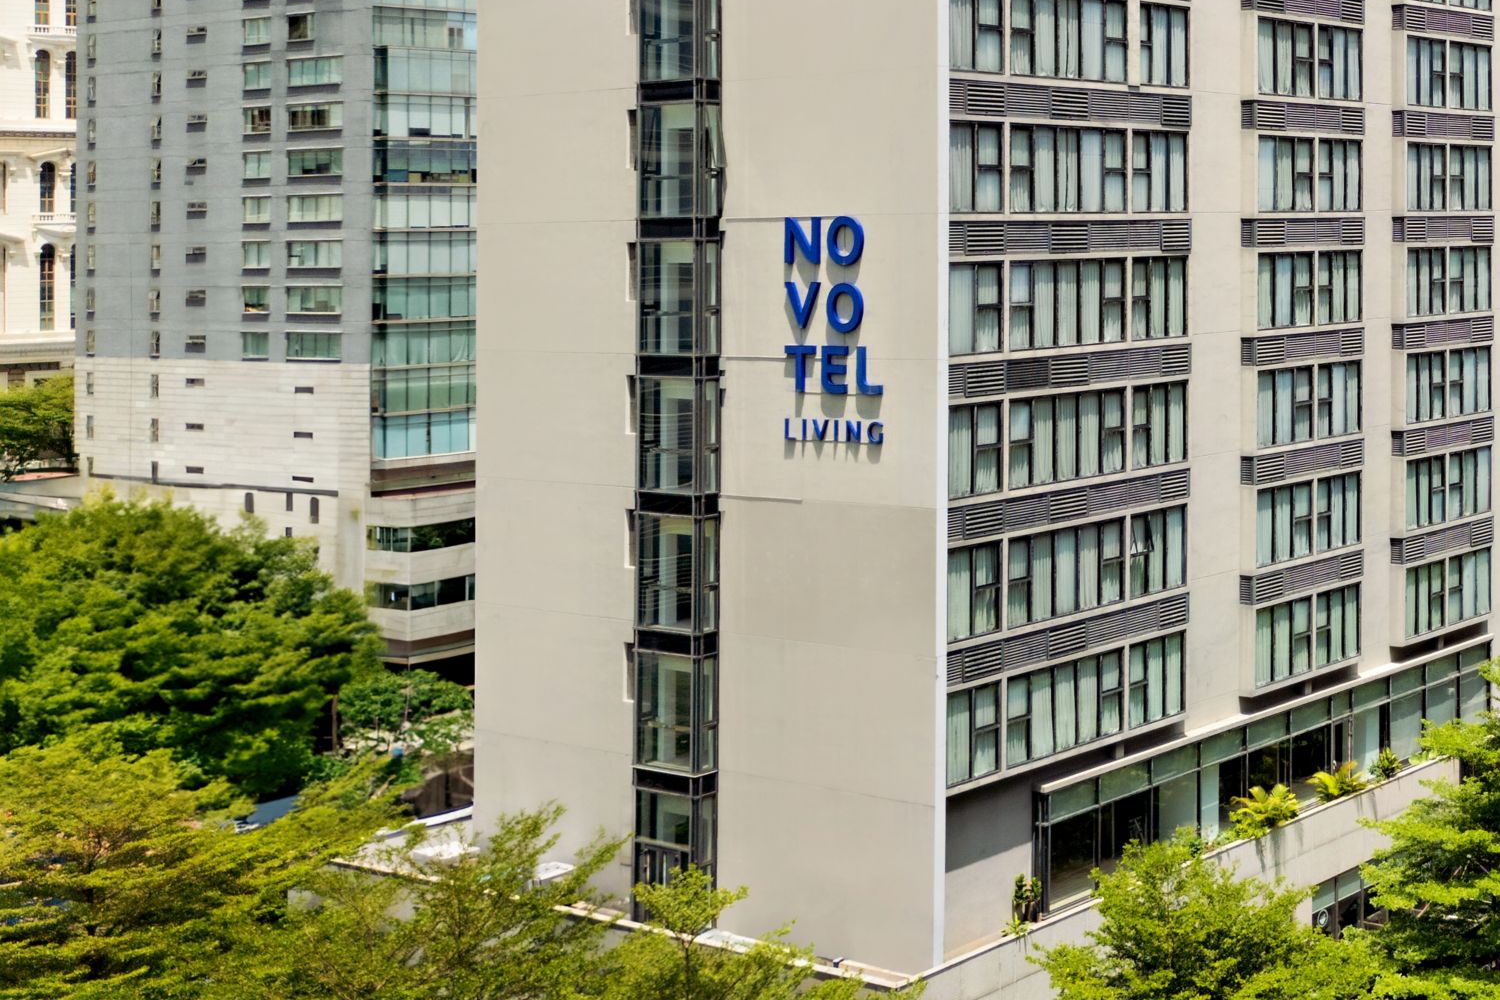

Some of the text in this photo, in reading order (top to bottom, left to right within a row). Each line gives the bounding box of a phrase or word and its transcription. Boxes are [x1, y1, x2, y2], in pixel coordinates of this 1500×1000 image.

[784, 216, 865, 265] NO
[784, 281, 864, 333] VO
[784, 345, 884, 395] TEL
[784, 418, 884, 445] LIVING
